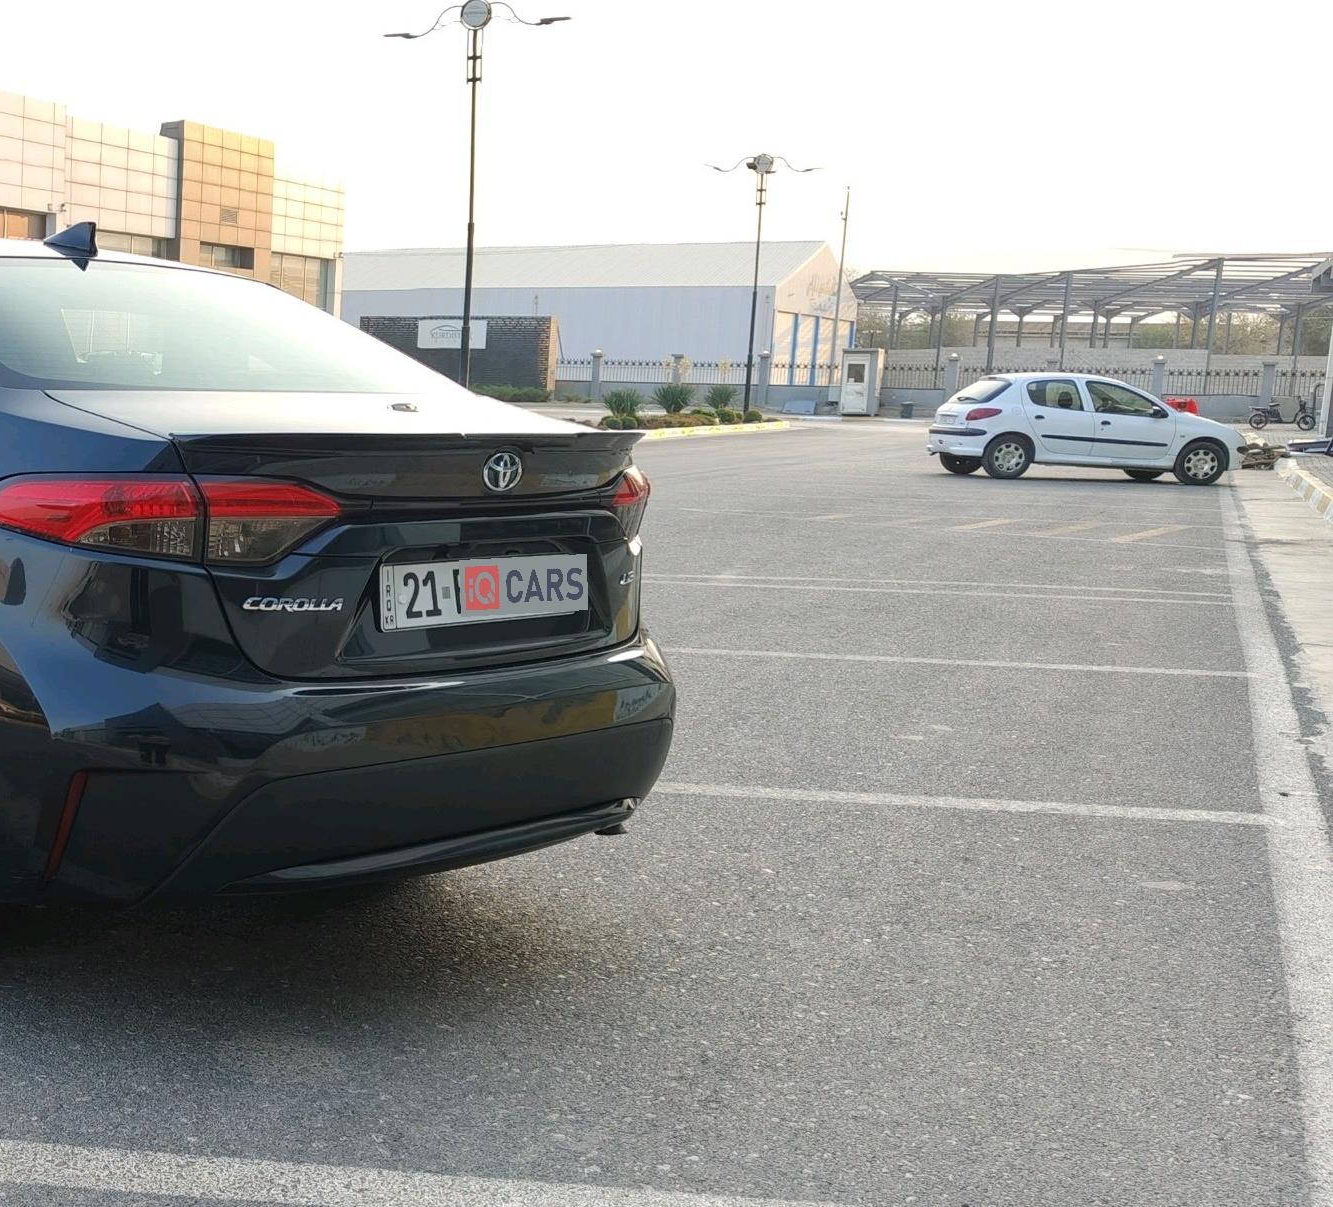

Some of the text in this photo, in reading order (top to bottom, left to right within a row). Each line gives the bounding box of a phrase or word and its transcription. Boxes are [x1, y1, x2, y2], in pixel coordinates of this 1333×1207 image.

[619, 570, 635, 585] LE
[403, 570, 442, 619] 21
[242, 596, 344, 612] COROLLA
